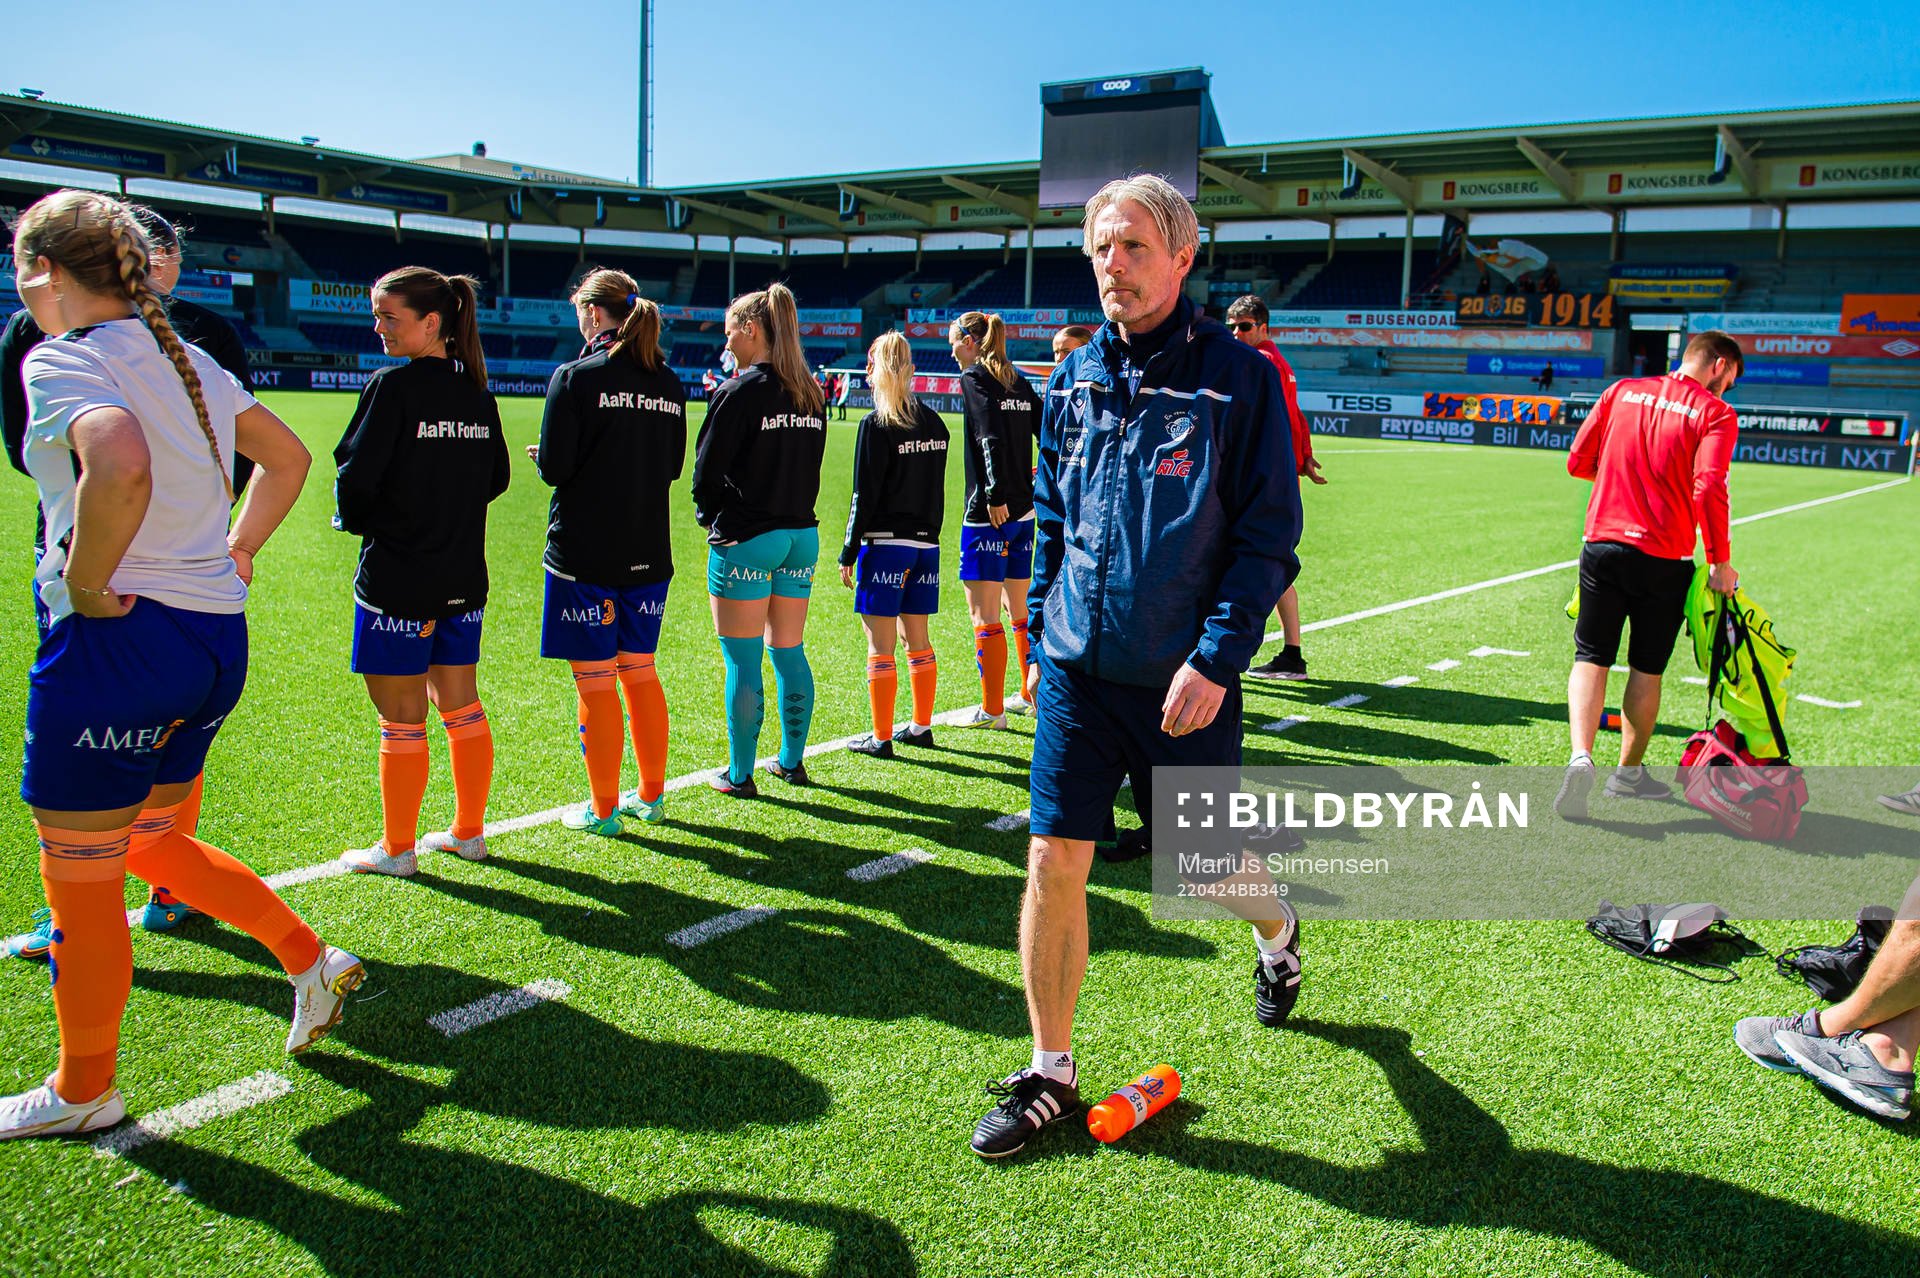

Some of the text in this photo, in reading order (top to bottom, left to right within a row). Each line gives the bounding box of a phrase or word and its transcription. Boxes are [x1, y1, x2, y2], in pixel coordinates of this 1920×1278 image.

[1102, 80, 1131, 91] coop
[1459, 181, 1539, 197] KONGSBERG
[1627, 174, 1710, 190] KONGSBER
[1311, 189, 1384, 200] KONBERG
[1459, 296, 1526, 315] 20 16
[1539, 292, 1614, 328] 1914
[1365, 314, 1456, 326] BUSENGDAL
[821, 325, 857, 337] umbro
[1754, 336, 1831, 355] umbro
[311, 371, 370, 385] FRYDEN
[487, 380, 547, 394] Eiendom
[599, 392, 634, 409] AaFK
[1326, 394, 1392, 412] TESS
[418, 421, 455, 438] AaFK
[761, 413, 787, 431] AaFK
[1737, 415, 1819, 432] OPTIMERA
[1312, 416, 1350, 434] NXT
[1380, 417, 1475, 437] FRYDENBØ
[1492, 428, 1518, 446] Bil
[1842, 446, 1896, 470] NXT
[630, 564, 650, 572] umbro
[560, 604, 602, 624] AMFI
[370, 615, 421, 633] AMFI
[73, 726, 164, 751] AMFI
